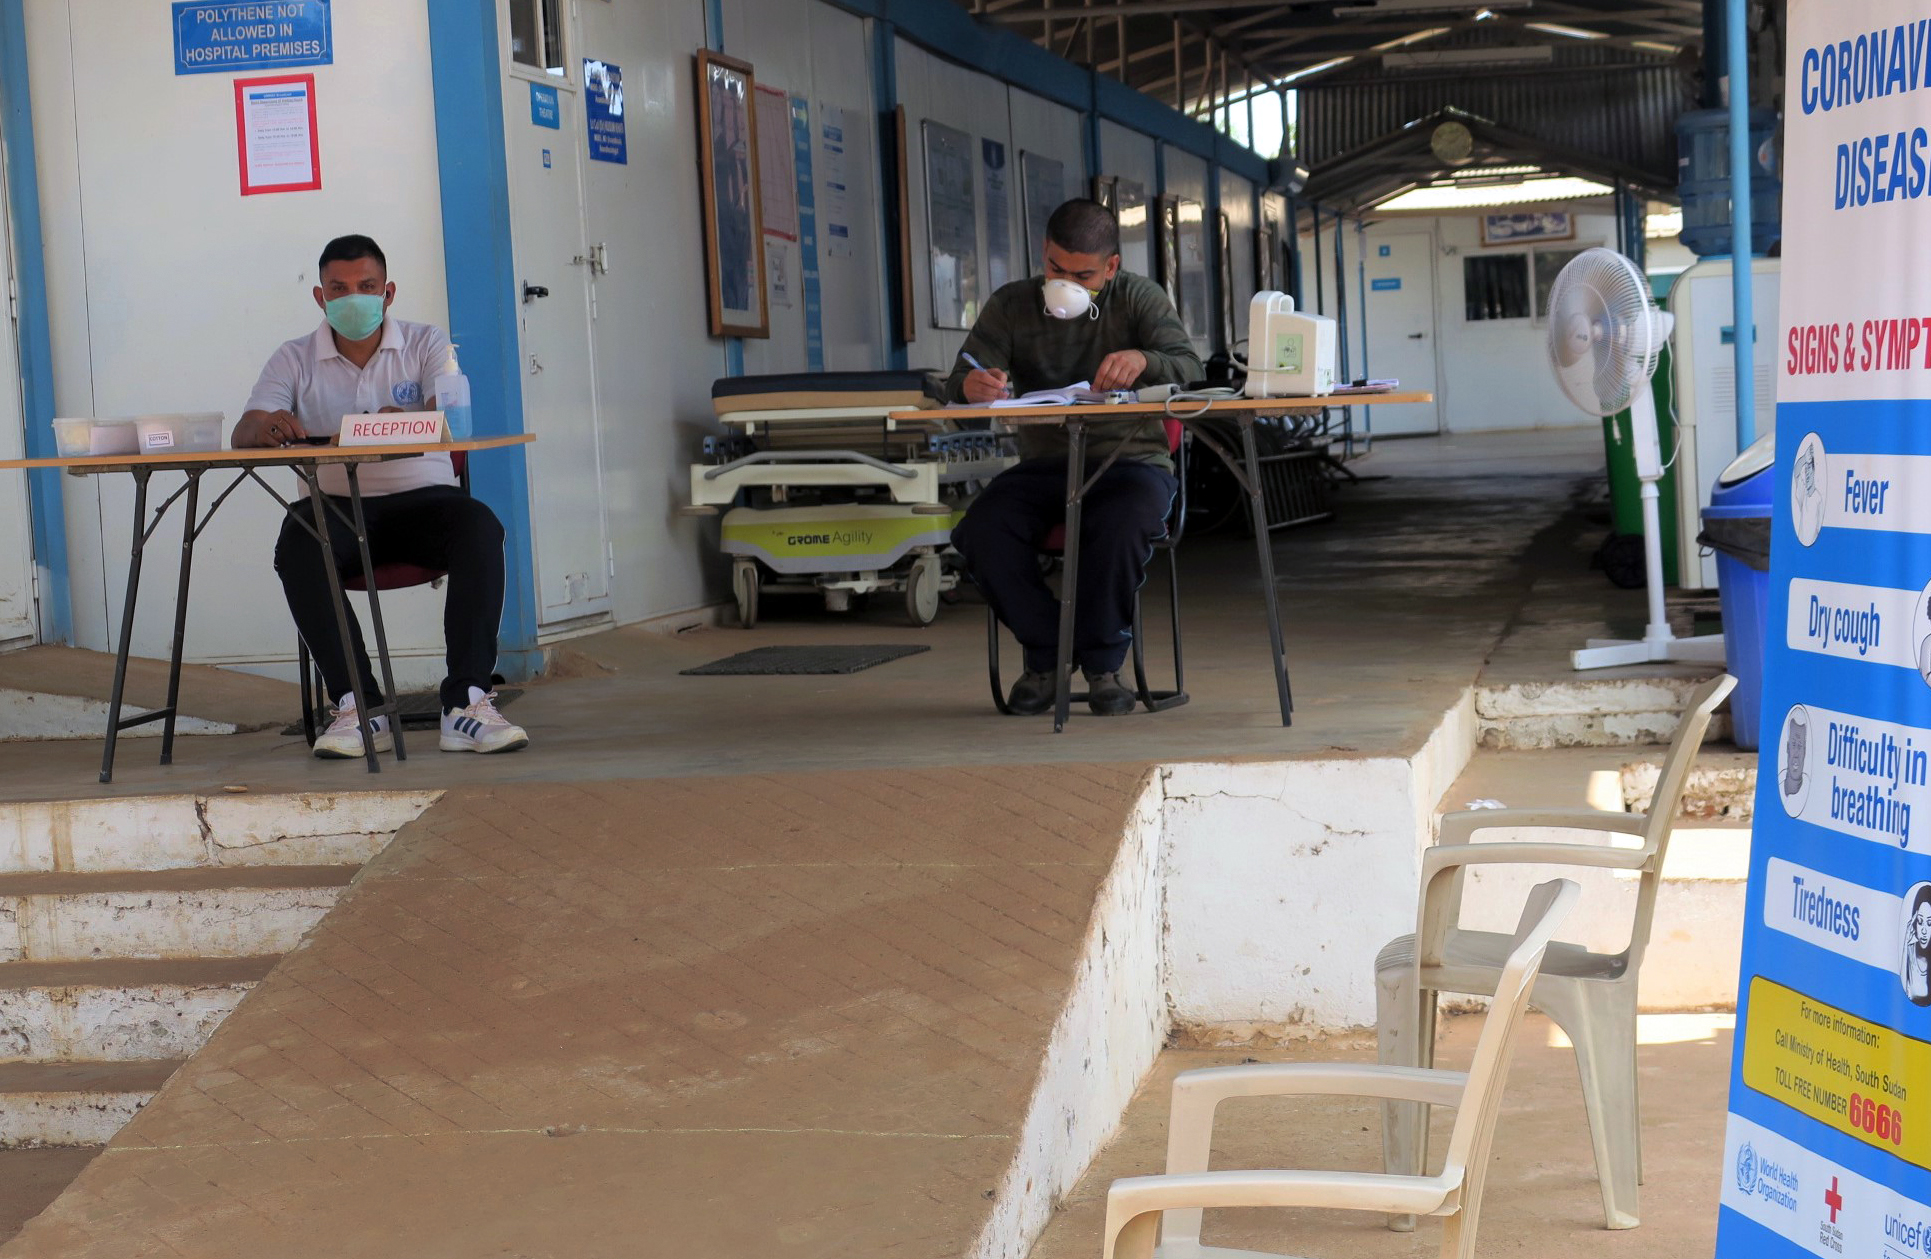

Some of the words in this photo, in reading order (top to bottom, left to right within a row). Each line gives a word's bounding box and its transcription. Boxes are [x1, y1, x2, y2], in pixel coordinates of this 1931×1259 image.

[196, 5, 274, 24] POLYTHENE
[277, 3, 305, 18] NOT
[211, 24, 276, 42] ALLOWED
[280, 23, 293, 36] IN
[186, 45, 249, 62] HOSPITAL
[252, 40, 320, 58] PREMISES
[1834, 127, 1931, 210] DISEAS
[1787, 323, 1839, 376] SIGNS
[1843, 322, 1855, 373] &
[353, 421, 437, 437] RECEPTION
[1844, 469, 1889, 515] Fever
[832, 530, 873, 546] Agility
[1809, 594, 1832, 649] Dry
[1834, 602, 1880, 656] cough
[1827, 722, 1901, 790] Difficulty
[1905, 738, 1927, 786] in
[1831, 775, 1911, 848] breathing
[1792, 875, 1860, 941] Tiredness
[1800, 1001, 1812, 1019] For
[1812, 1010, 1831, 1029] more
[1832, 1014, 1880, 1049] information:
[1775, 1029, 1788, 1049] Call
[1789, 1034, 1815, 1065] Ministry
[1816, 1049, 1825, 1064] of
[1826, 1051, 1853, 1081] Health,
[1855, 1064, 1879, 1089] South
[1882, 1075, 1907, 1101] Sudan
[1775, 1067, 1792, 1090] TOLL
[1794, 1076, 1812, 1100] FREE
[1813, 1085, 1847, 1116] NUMBER
[1849, 1092, 1902, 1146] 6666
[1757, 1178, 1797, 1212] Organization
[1760, 1157, 1779, 1181] World
[1779, 1165, 1798, 1192] Health
[1820, 1231, 1829, 1247] Red
[1829, 1237, 1843, 1254] Cross
[1884, 1213, 1922, 1250] unicef
